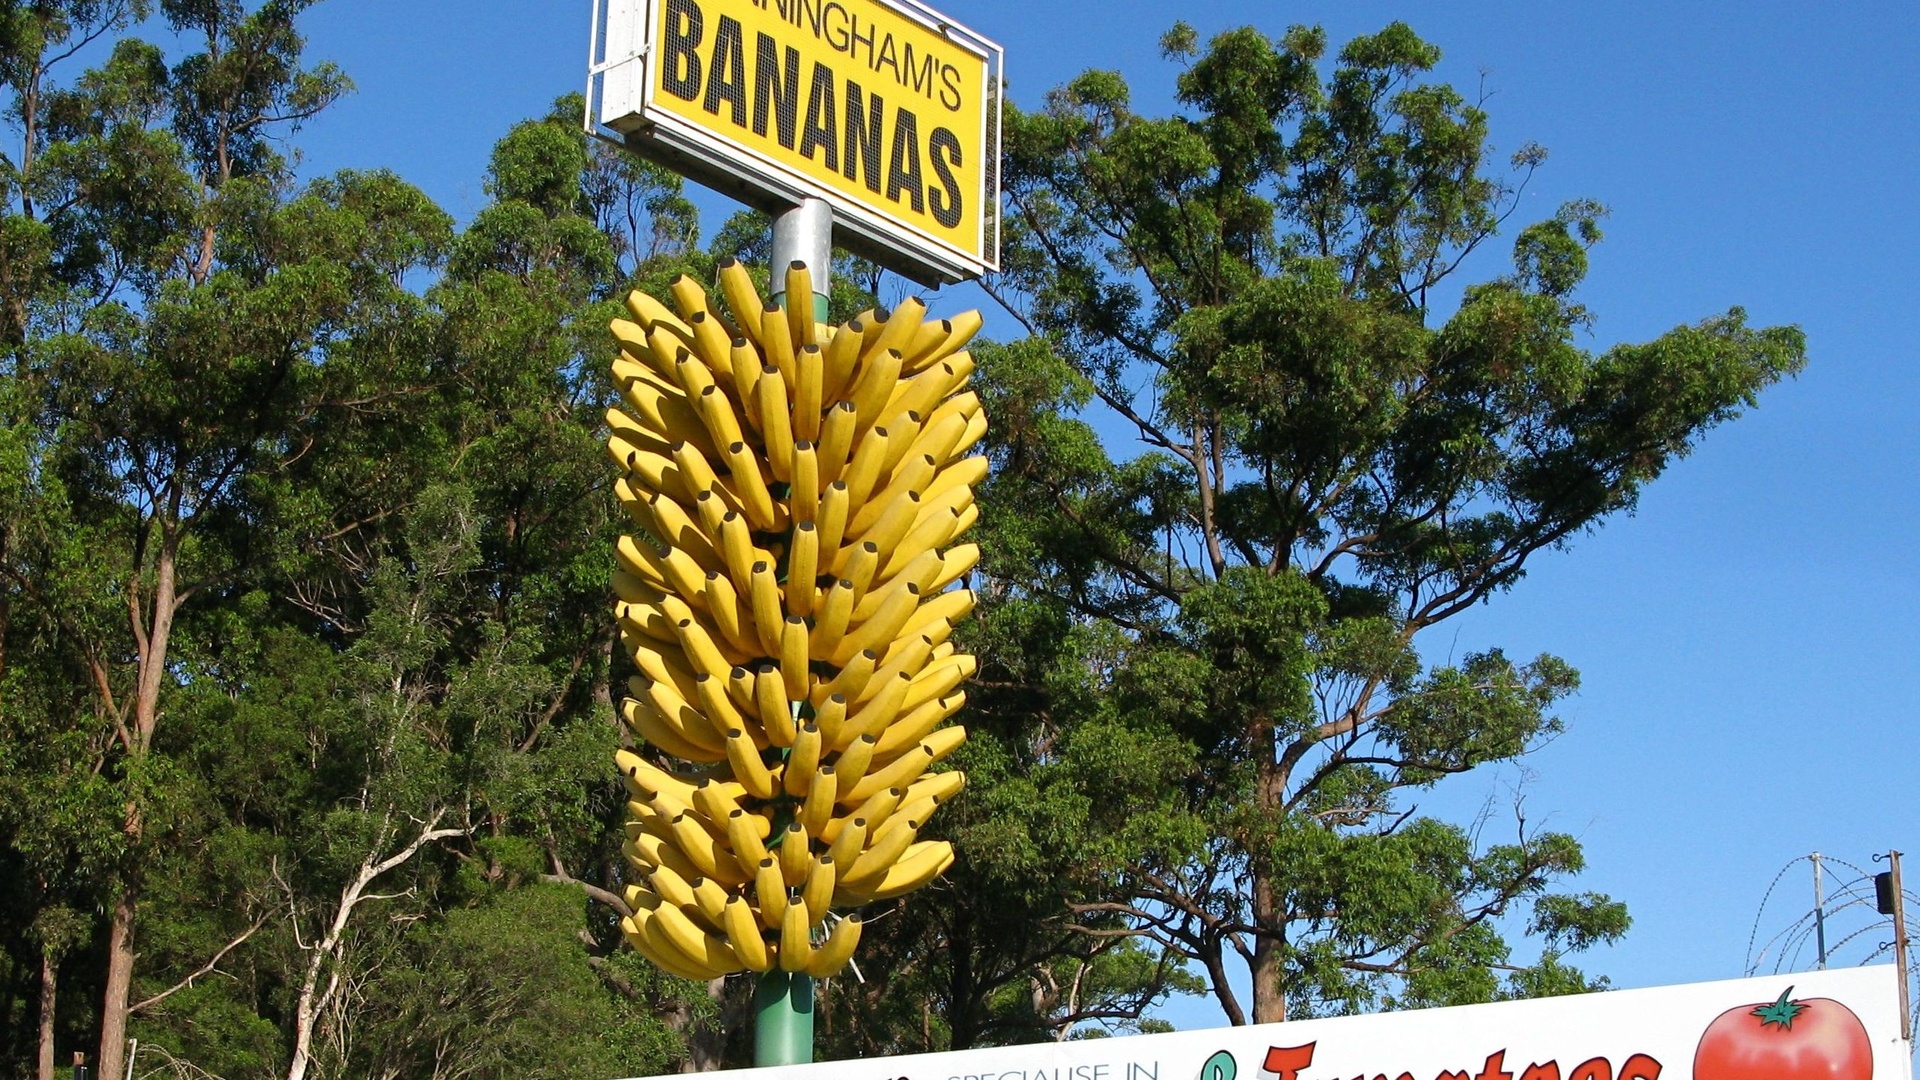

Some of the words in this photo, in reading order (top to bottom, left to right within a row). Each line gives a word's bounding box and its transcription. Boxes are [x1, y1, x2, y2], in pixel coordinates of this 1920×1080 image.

[662, 0, 962, 229] BANANAS
[947, 1064, 1109, 1080] ALISE
[1127, 1061, 1158, 1080] IN
